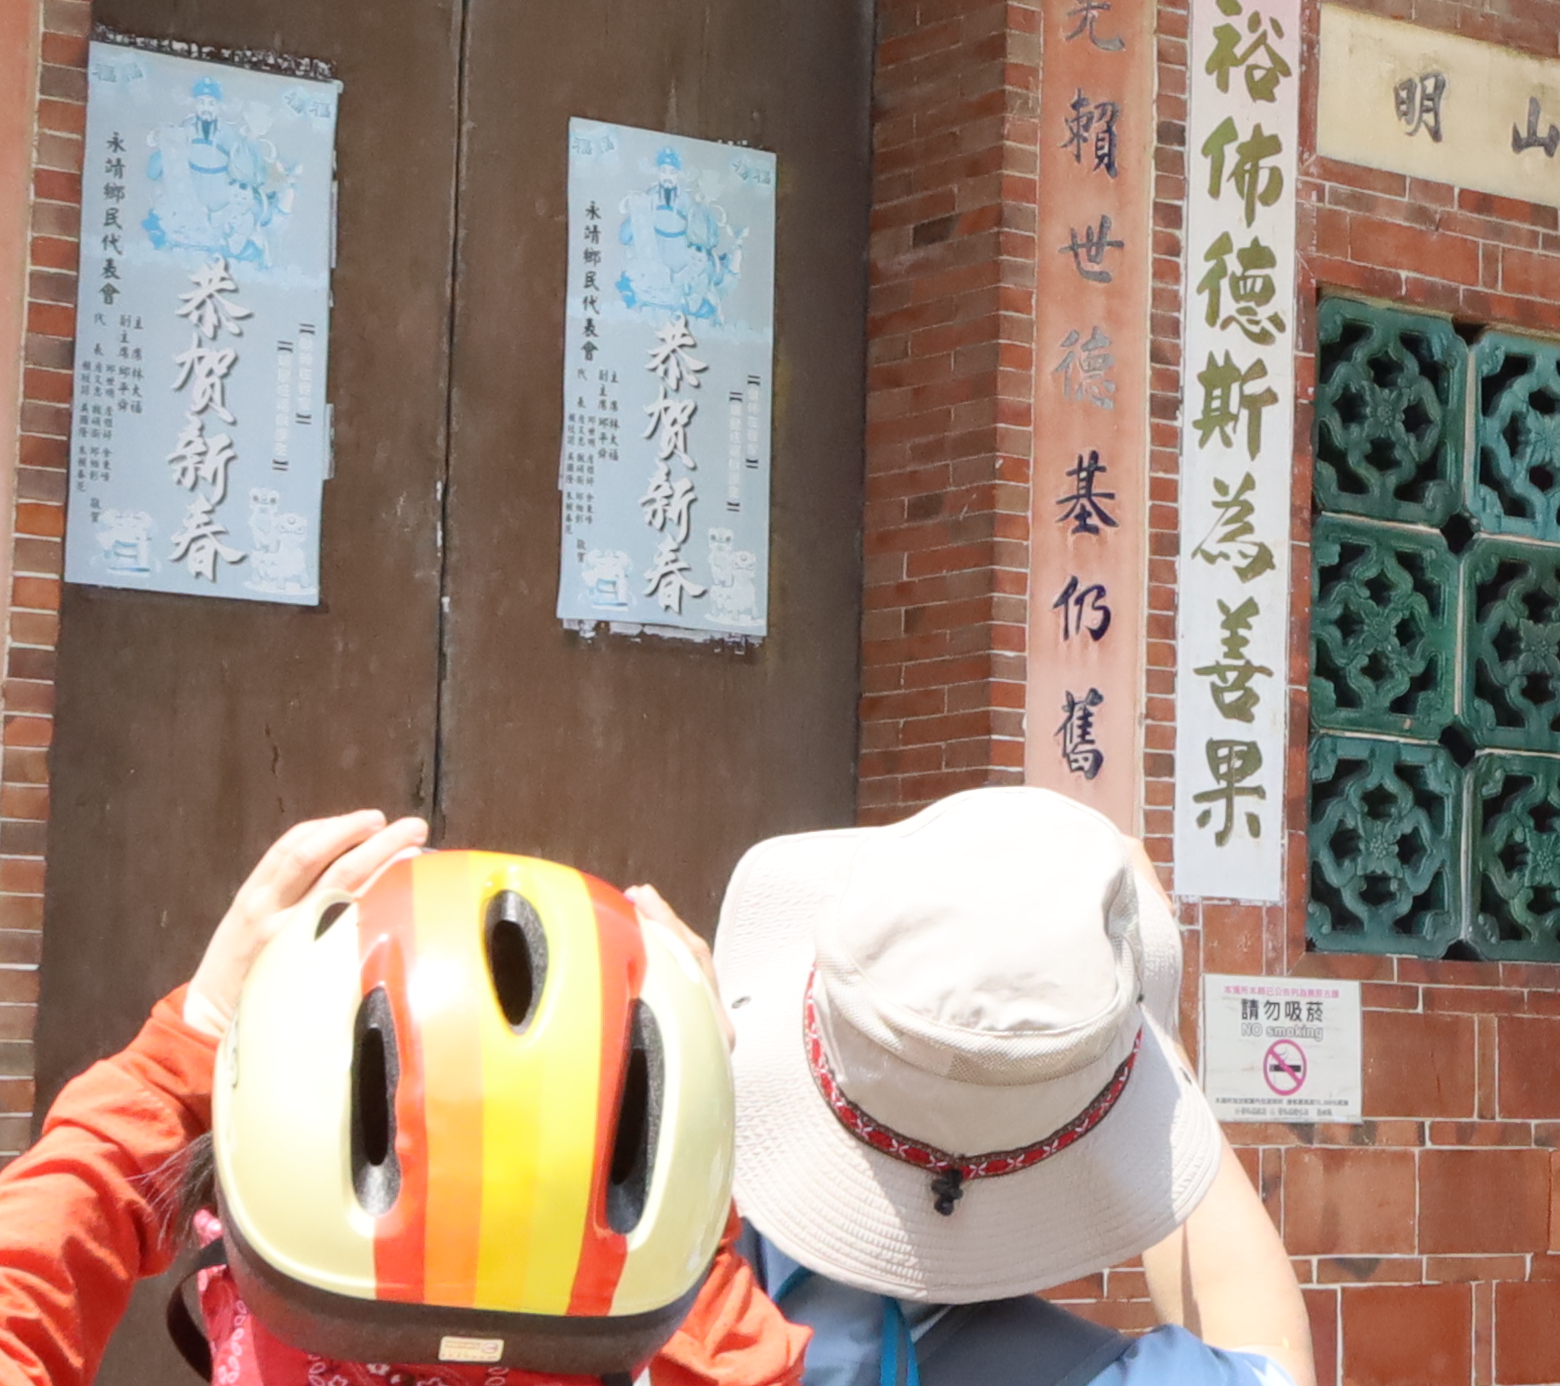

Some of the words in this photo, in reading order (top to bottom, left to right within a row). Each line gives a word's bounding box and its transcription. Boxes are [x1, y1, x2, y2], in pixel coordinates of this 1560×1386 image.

[98, 131, 127, 305] 永靖鄉民代表會
[580, 200, 602, 362] 永靖鄉民代表會
[1241, 999, 1324, 1022] 請勿吸菸
[1241, 1022, 1264, 1037] NO
[1266, 1024, 1324, 1042] smoking
